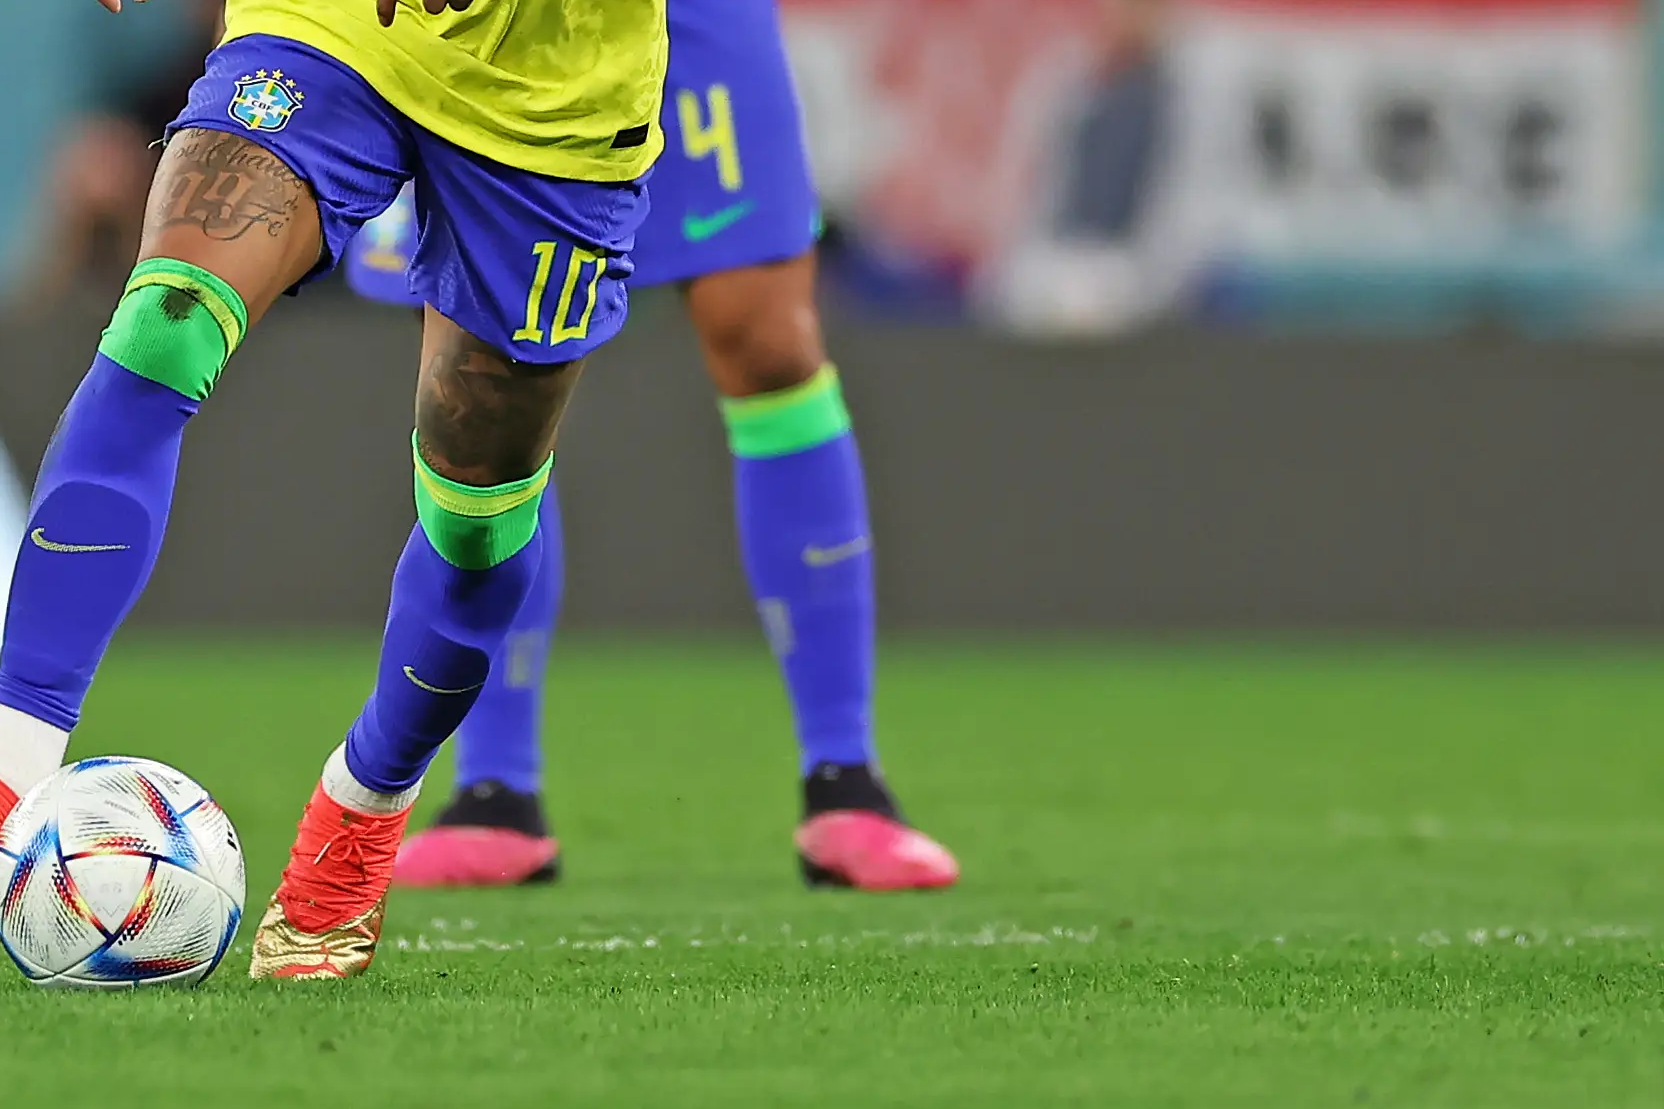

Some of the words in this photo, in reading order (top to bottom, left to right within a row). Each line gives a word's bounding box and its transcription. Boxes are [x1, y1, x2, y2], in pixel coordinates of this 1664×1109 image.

[251, 99, 274, 111] CBF
[676, 84, 743, 190] 4
[512, 241, 607, 346] 10
